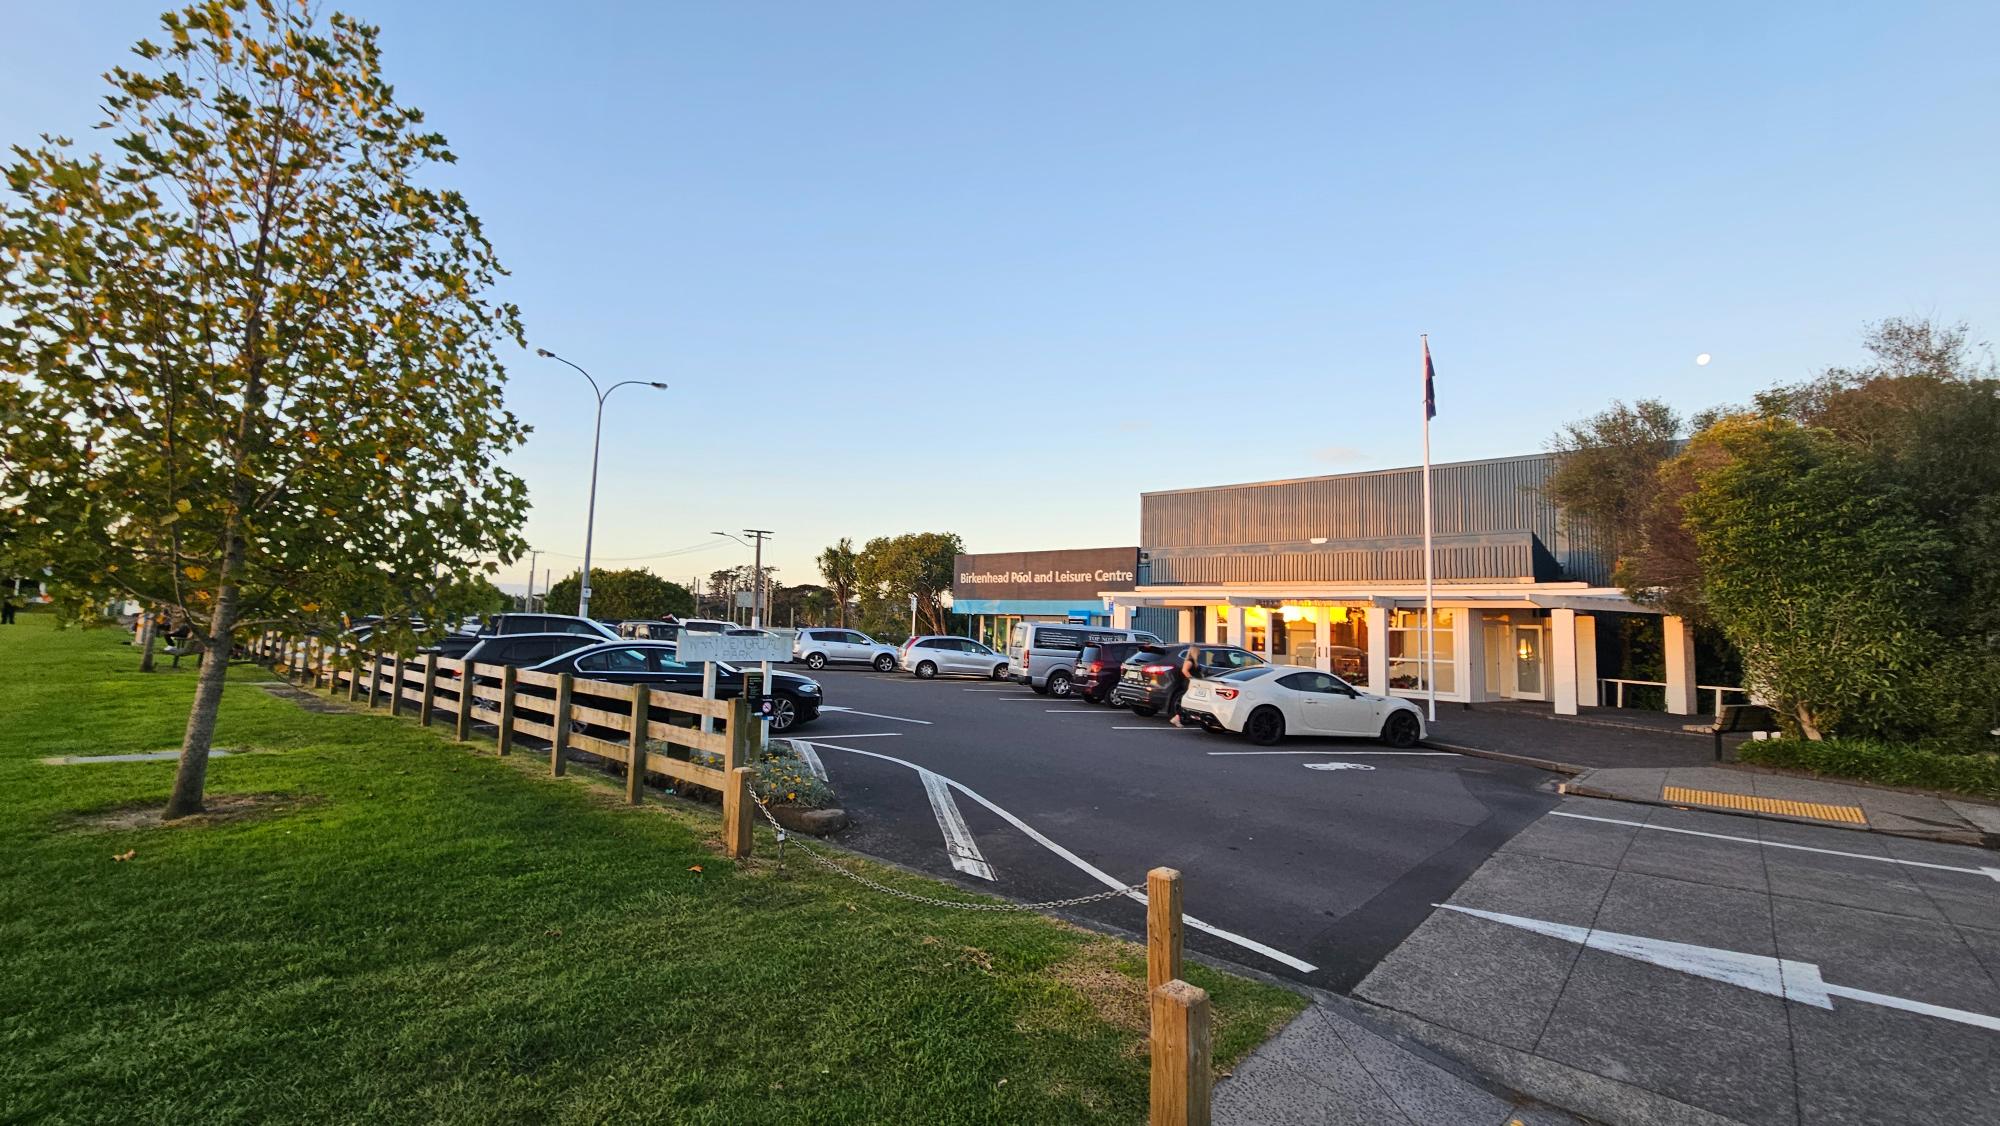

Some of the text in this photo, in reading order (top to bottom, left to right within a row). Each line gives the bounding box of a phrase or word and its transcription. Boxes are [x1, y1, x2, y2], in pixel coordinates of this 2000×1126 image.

[960, 572, 1009, 584] Birkenhead
[1034, 570, 1053, 583] and
[1055, 570, 1092, 583] Leisure
[1094, 569, 1133, 582] Centre
[722, 649, 753, 660] PARK
